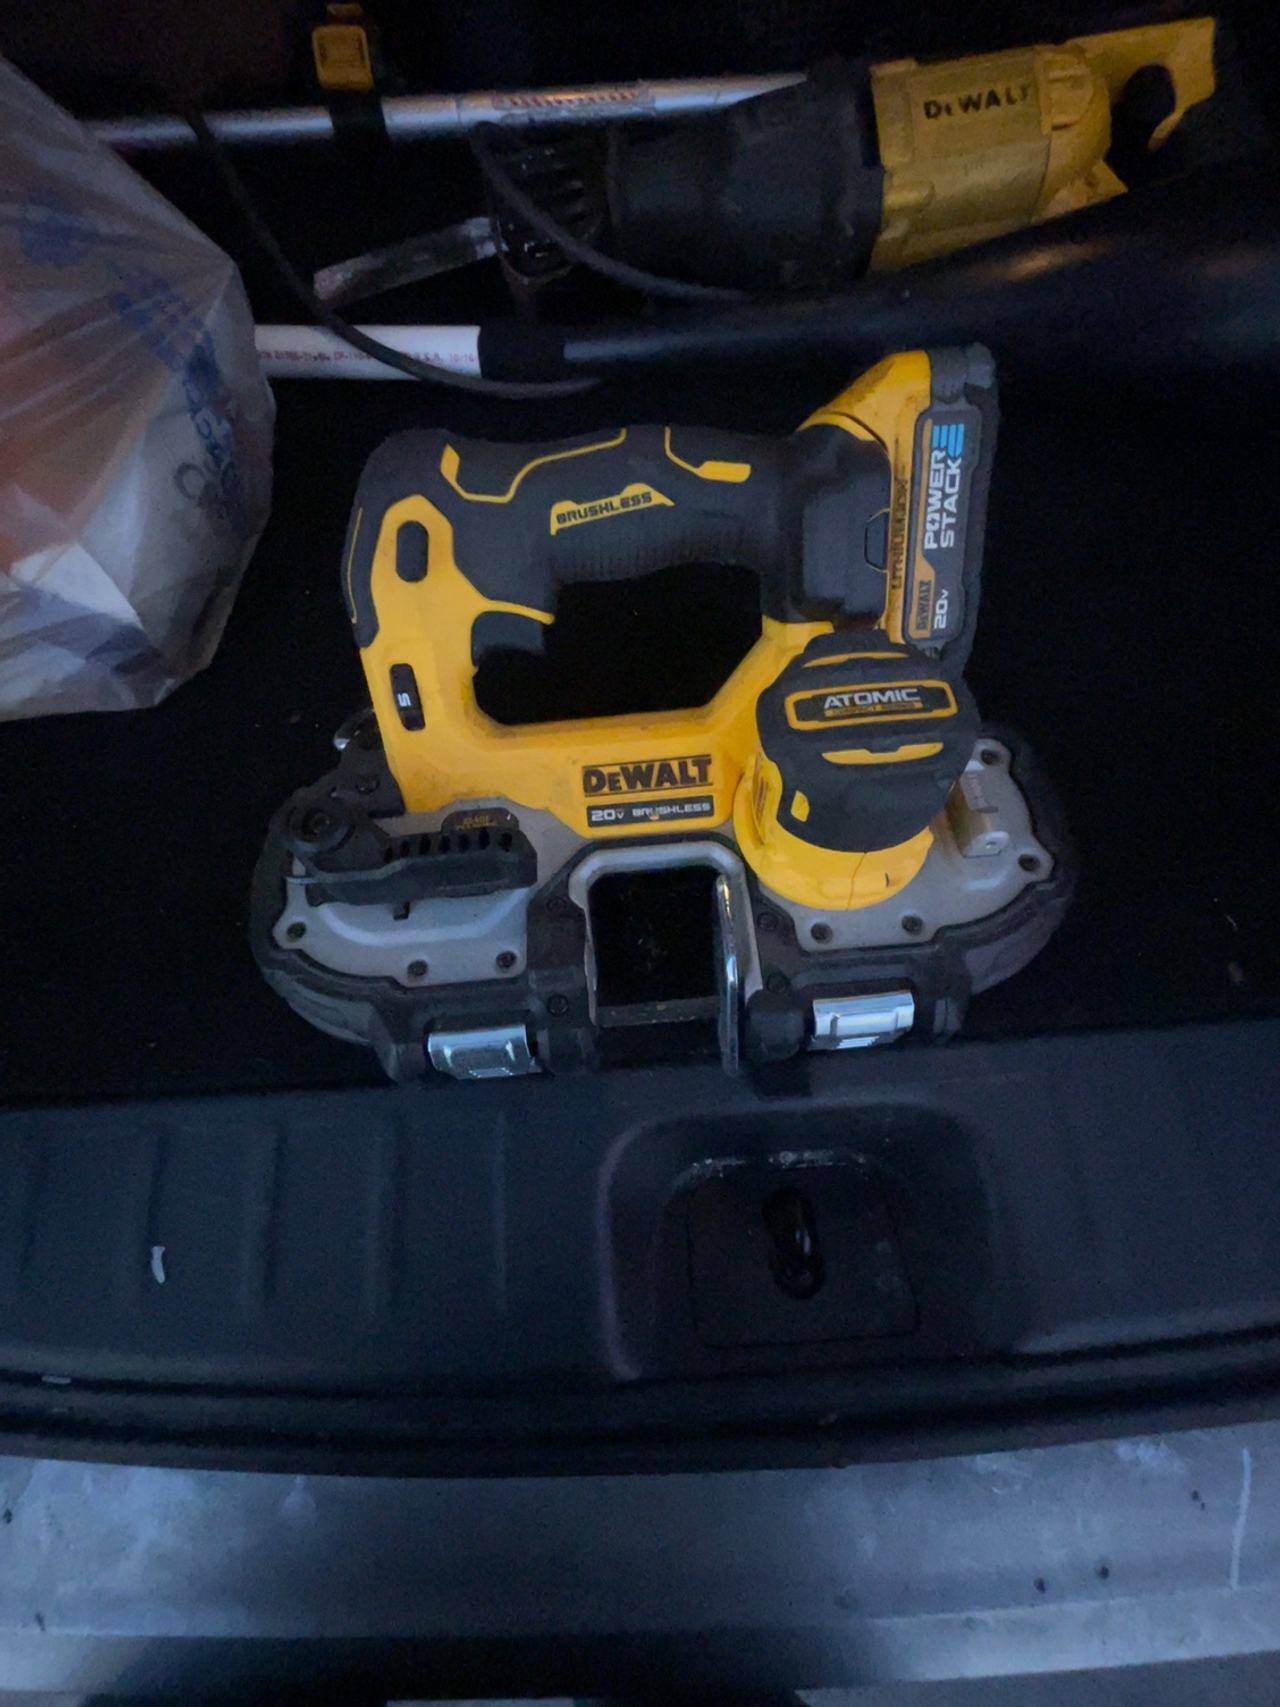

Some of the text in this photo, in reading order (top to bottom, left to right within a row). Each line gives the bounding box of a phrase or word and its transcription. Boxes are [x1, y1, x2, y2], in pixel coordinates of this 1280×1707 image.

[556, 490, 653, 525] BRUSHLESS
[924, 449, 947, 550] POWER
[940, 457, 963, 548] STACK
[823, 688, 922, 709] ATOMIC
[583, 757, 713, 794] DeWALT
[632, 802, 711, 817] BRUSHLESS
